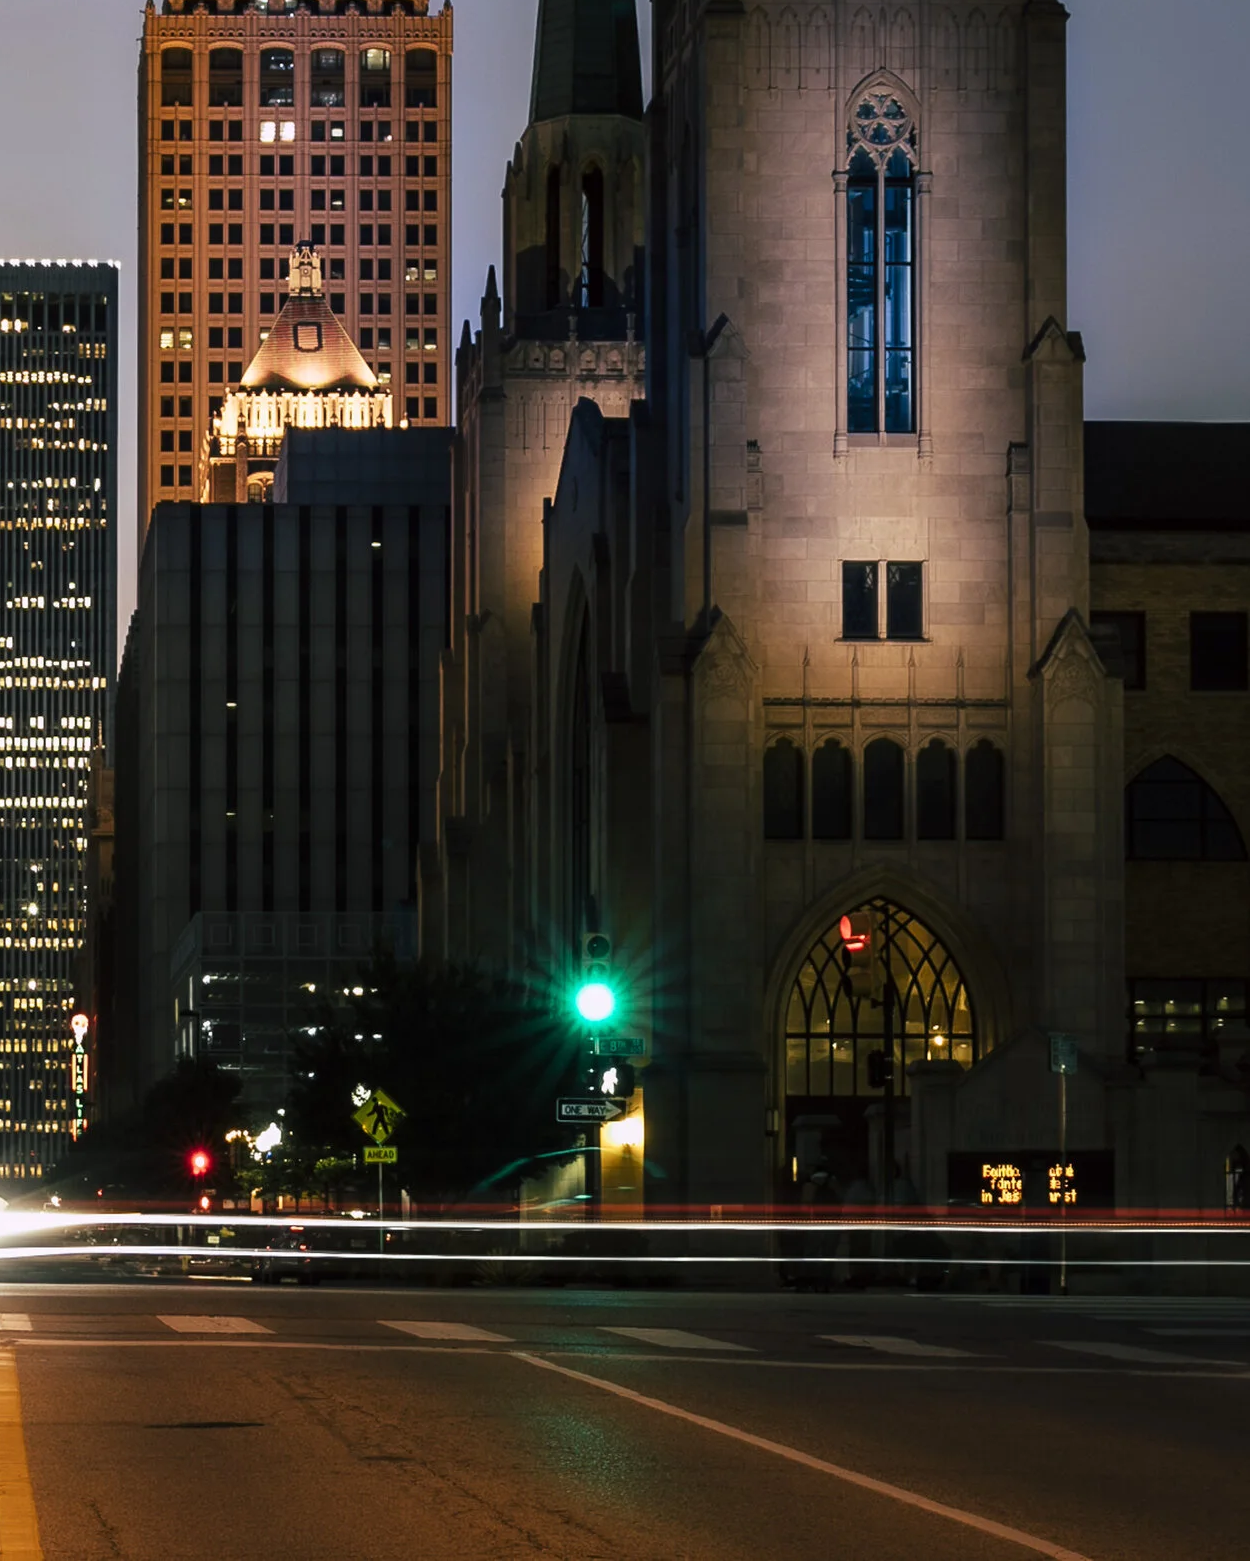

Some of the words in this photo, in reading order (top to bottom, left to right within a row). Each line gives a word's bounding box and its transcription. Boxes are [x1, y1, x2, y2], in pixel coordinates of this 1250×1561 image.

[75, 1044, 85, 1094] ATLAS
[564, 1105, 583, 1115] ONE
[587, 1105, 606, 1115] WAY
[367, 1149, 395, 1159] AHEAD
